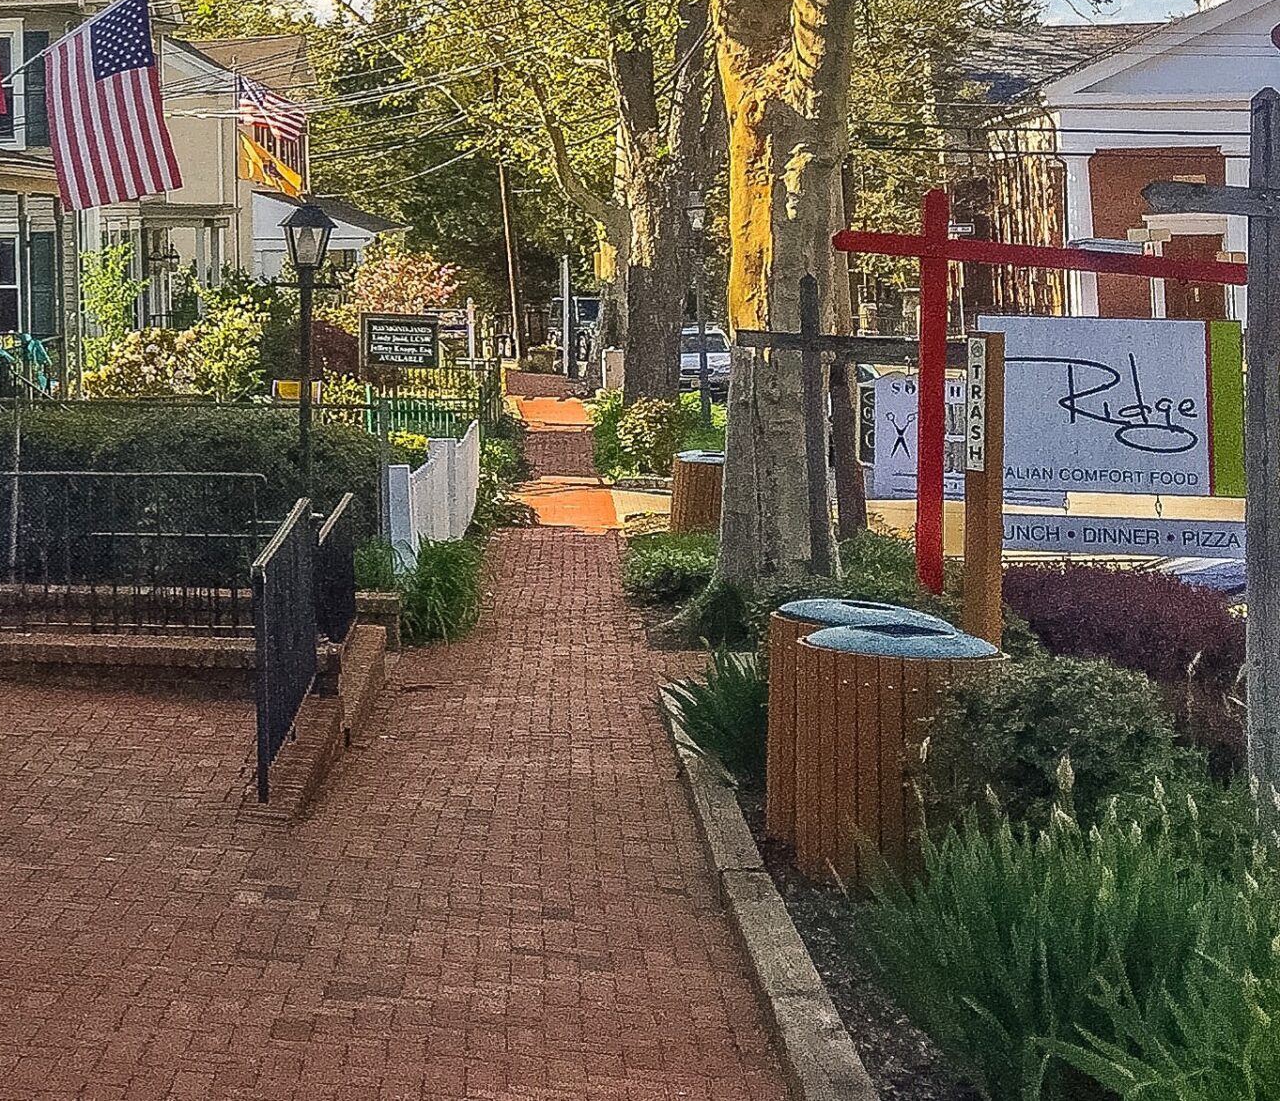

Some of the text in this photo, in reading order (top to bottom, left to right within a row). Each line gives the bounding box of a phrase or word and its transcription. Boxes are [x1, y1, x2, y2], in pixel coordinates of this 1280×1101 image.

[378, 355, 424, 363] AVAILABLE
[971, 364, 983, 461] TRASH
[1004, 353, 1199, 453] Ridge
[1004, 466, 1199, 486] ALIAN COMFORT FOOD
[1004, 525, 1241, 549] UNCH DINNER PIZZA
